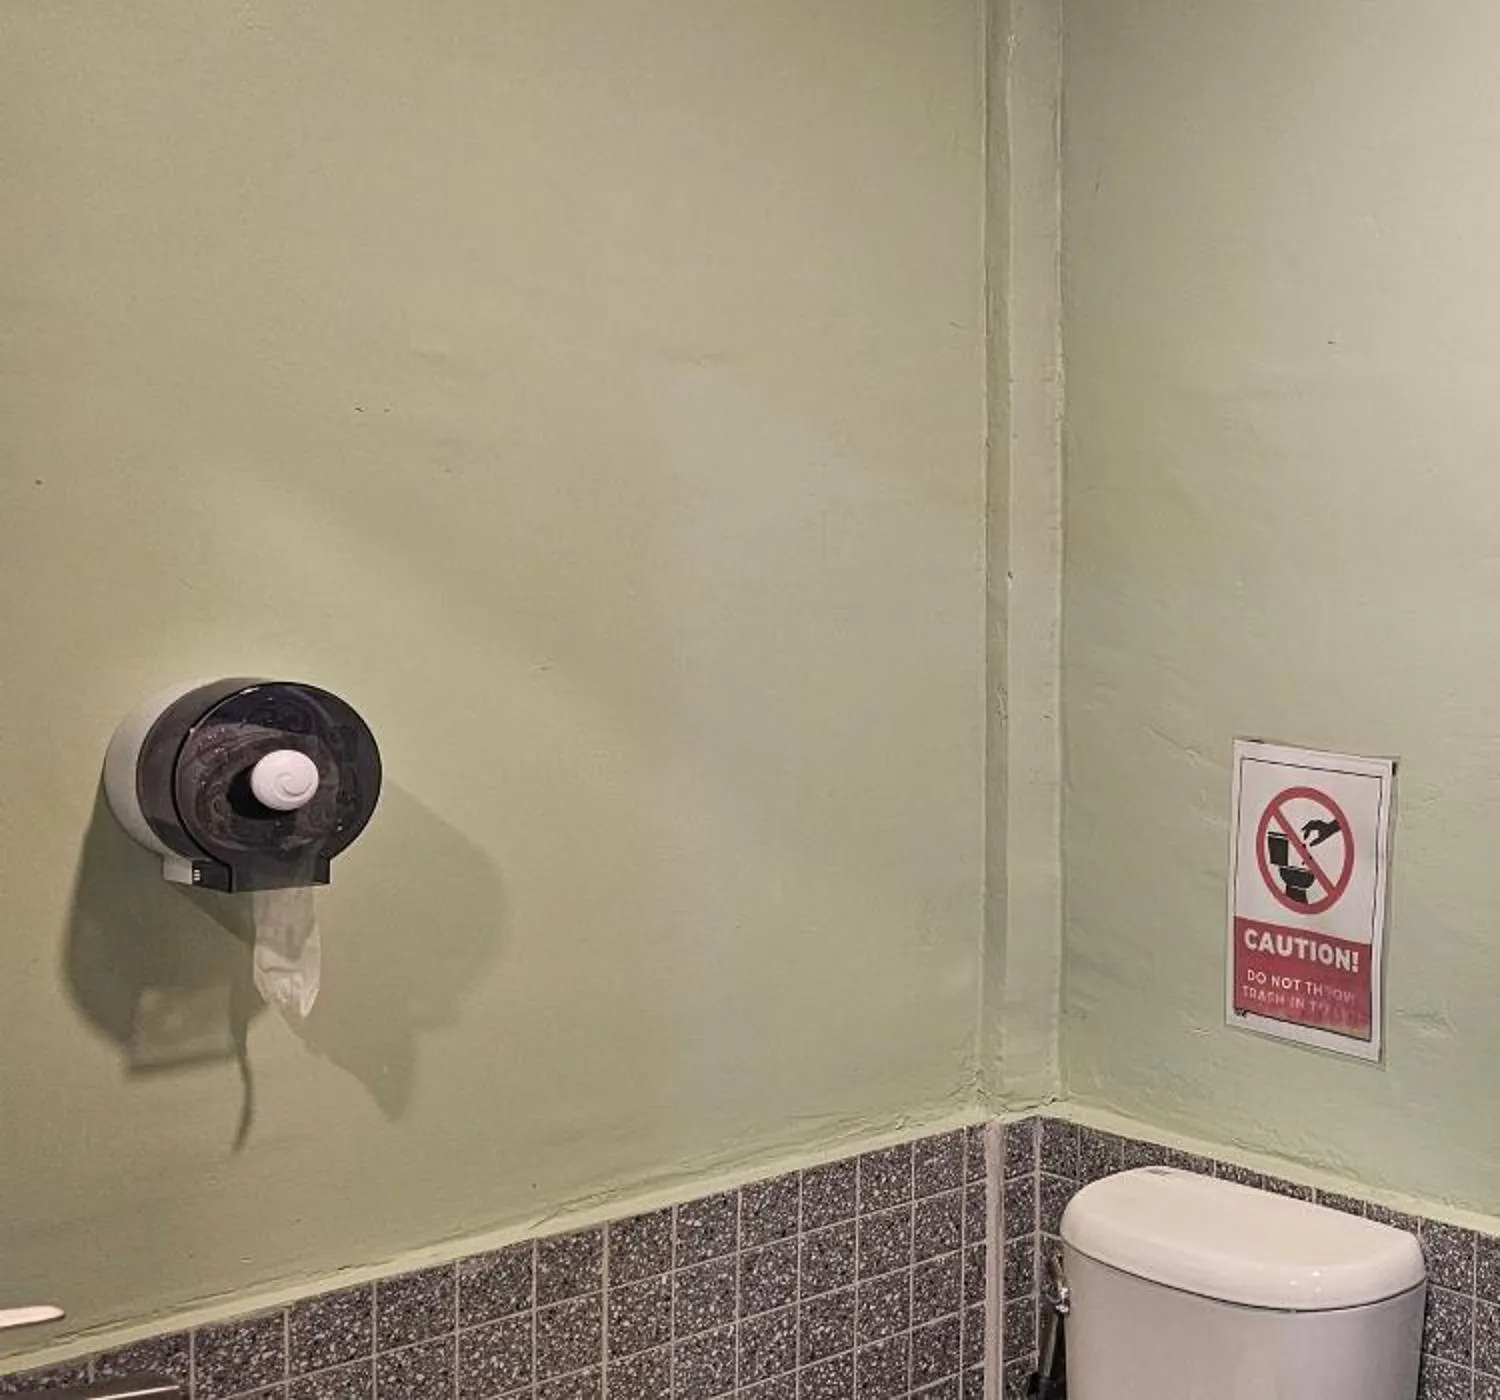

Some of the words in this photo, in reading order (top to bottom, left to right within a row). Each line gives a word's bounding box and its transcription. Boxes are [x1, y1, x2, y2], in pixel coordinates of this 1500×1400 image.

[1244, 928, 1360, 973] CAUTION!
[1247, 969, 1267, 984] DO
[1272, 975, 1301, 991] NOT
[1290, 996, 1305, 1009] IN
